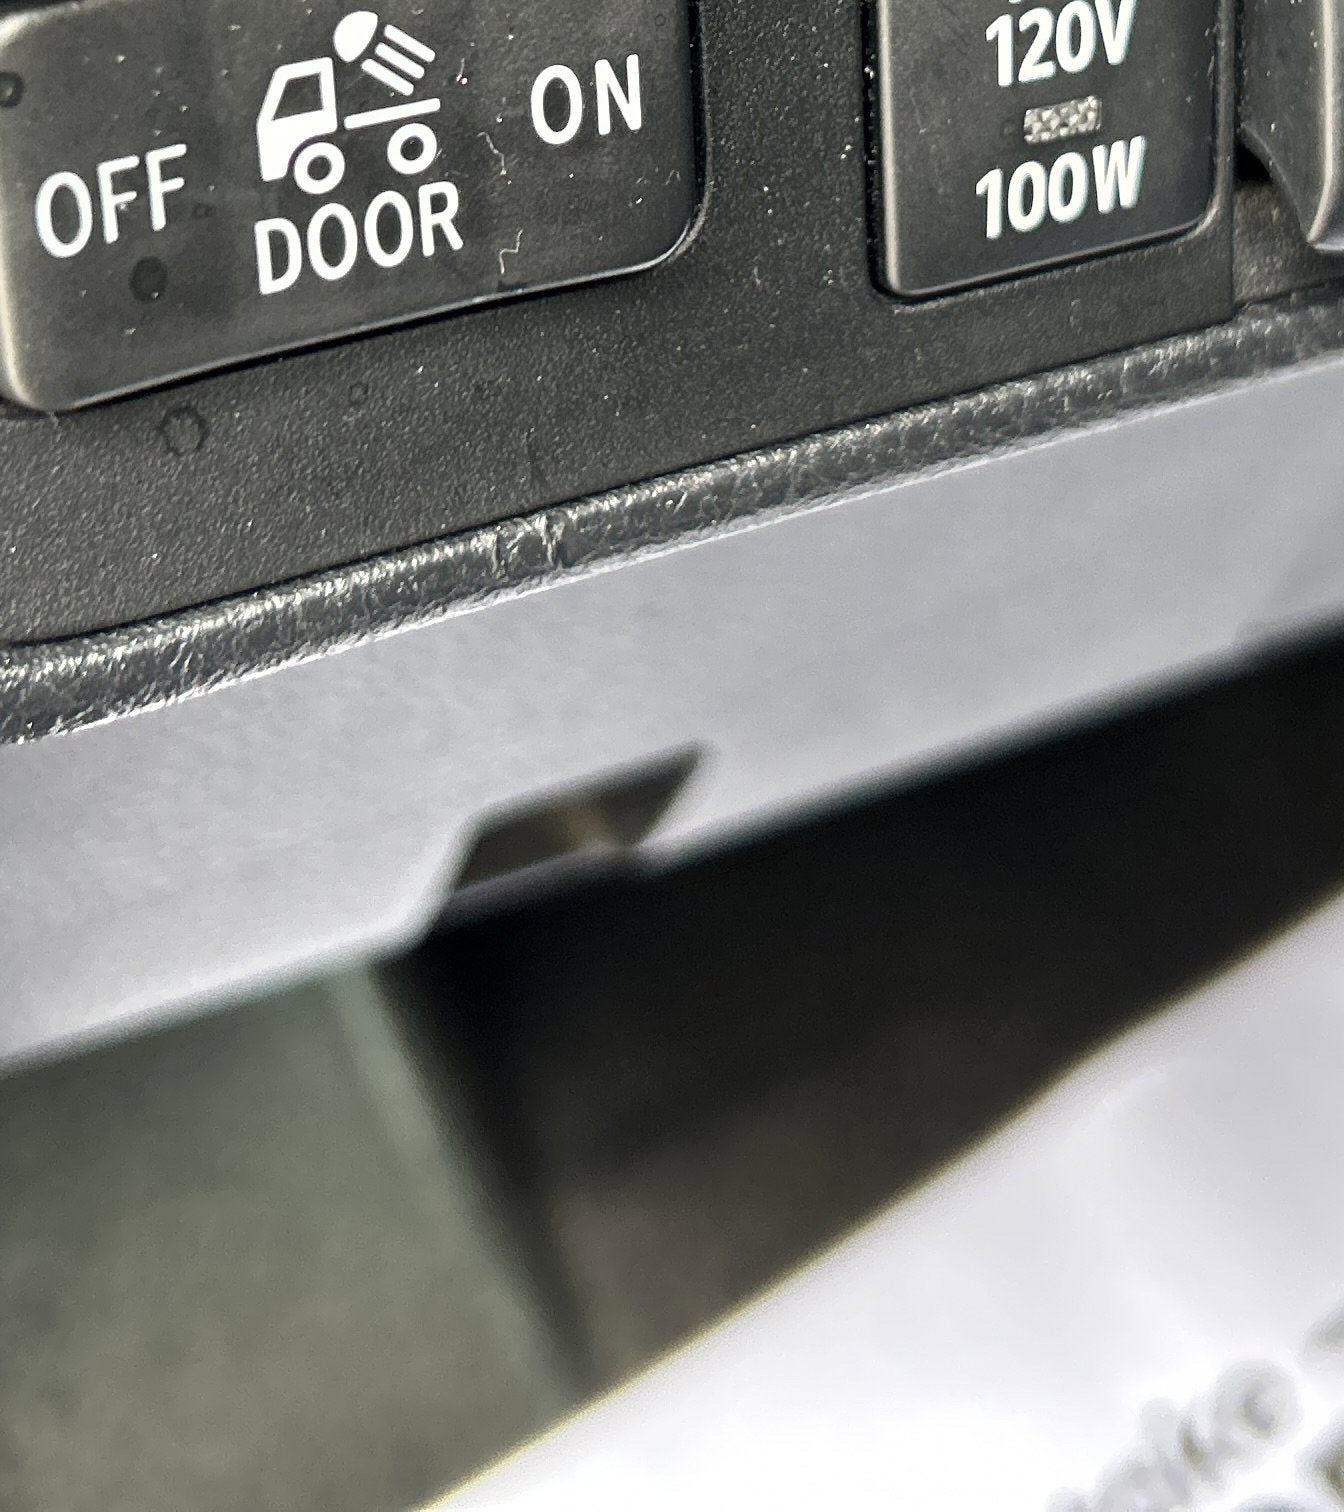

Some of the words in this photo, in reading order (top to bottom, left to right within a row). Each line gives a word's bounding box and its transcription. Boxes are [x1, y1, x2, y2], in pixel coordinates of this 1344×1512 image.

[33, 142, 188, 260] OFF
[529, 52, 643, 146] ON
[974, 134, 1147, 241] 100W
[252, 180, 465, 296] DOOR
